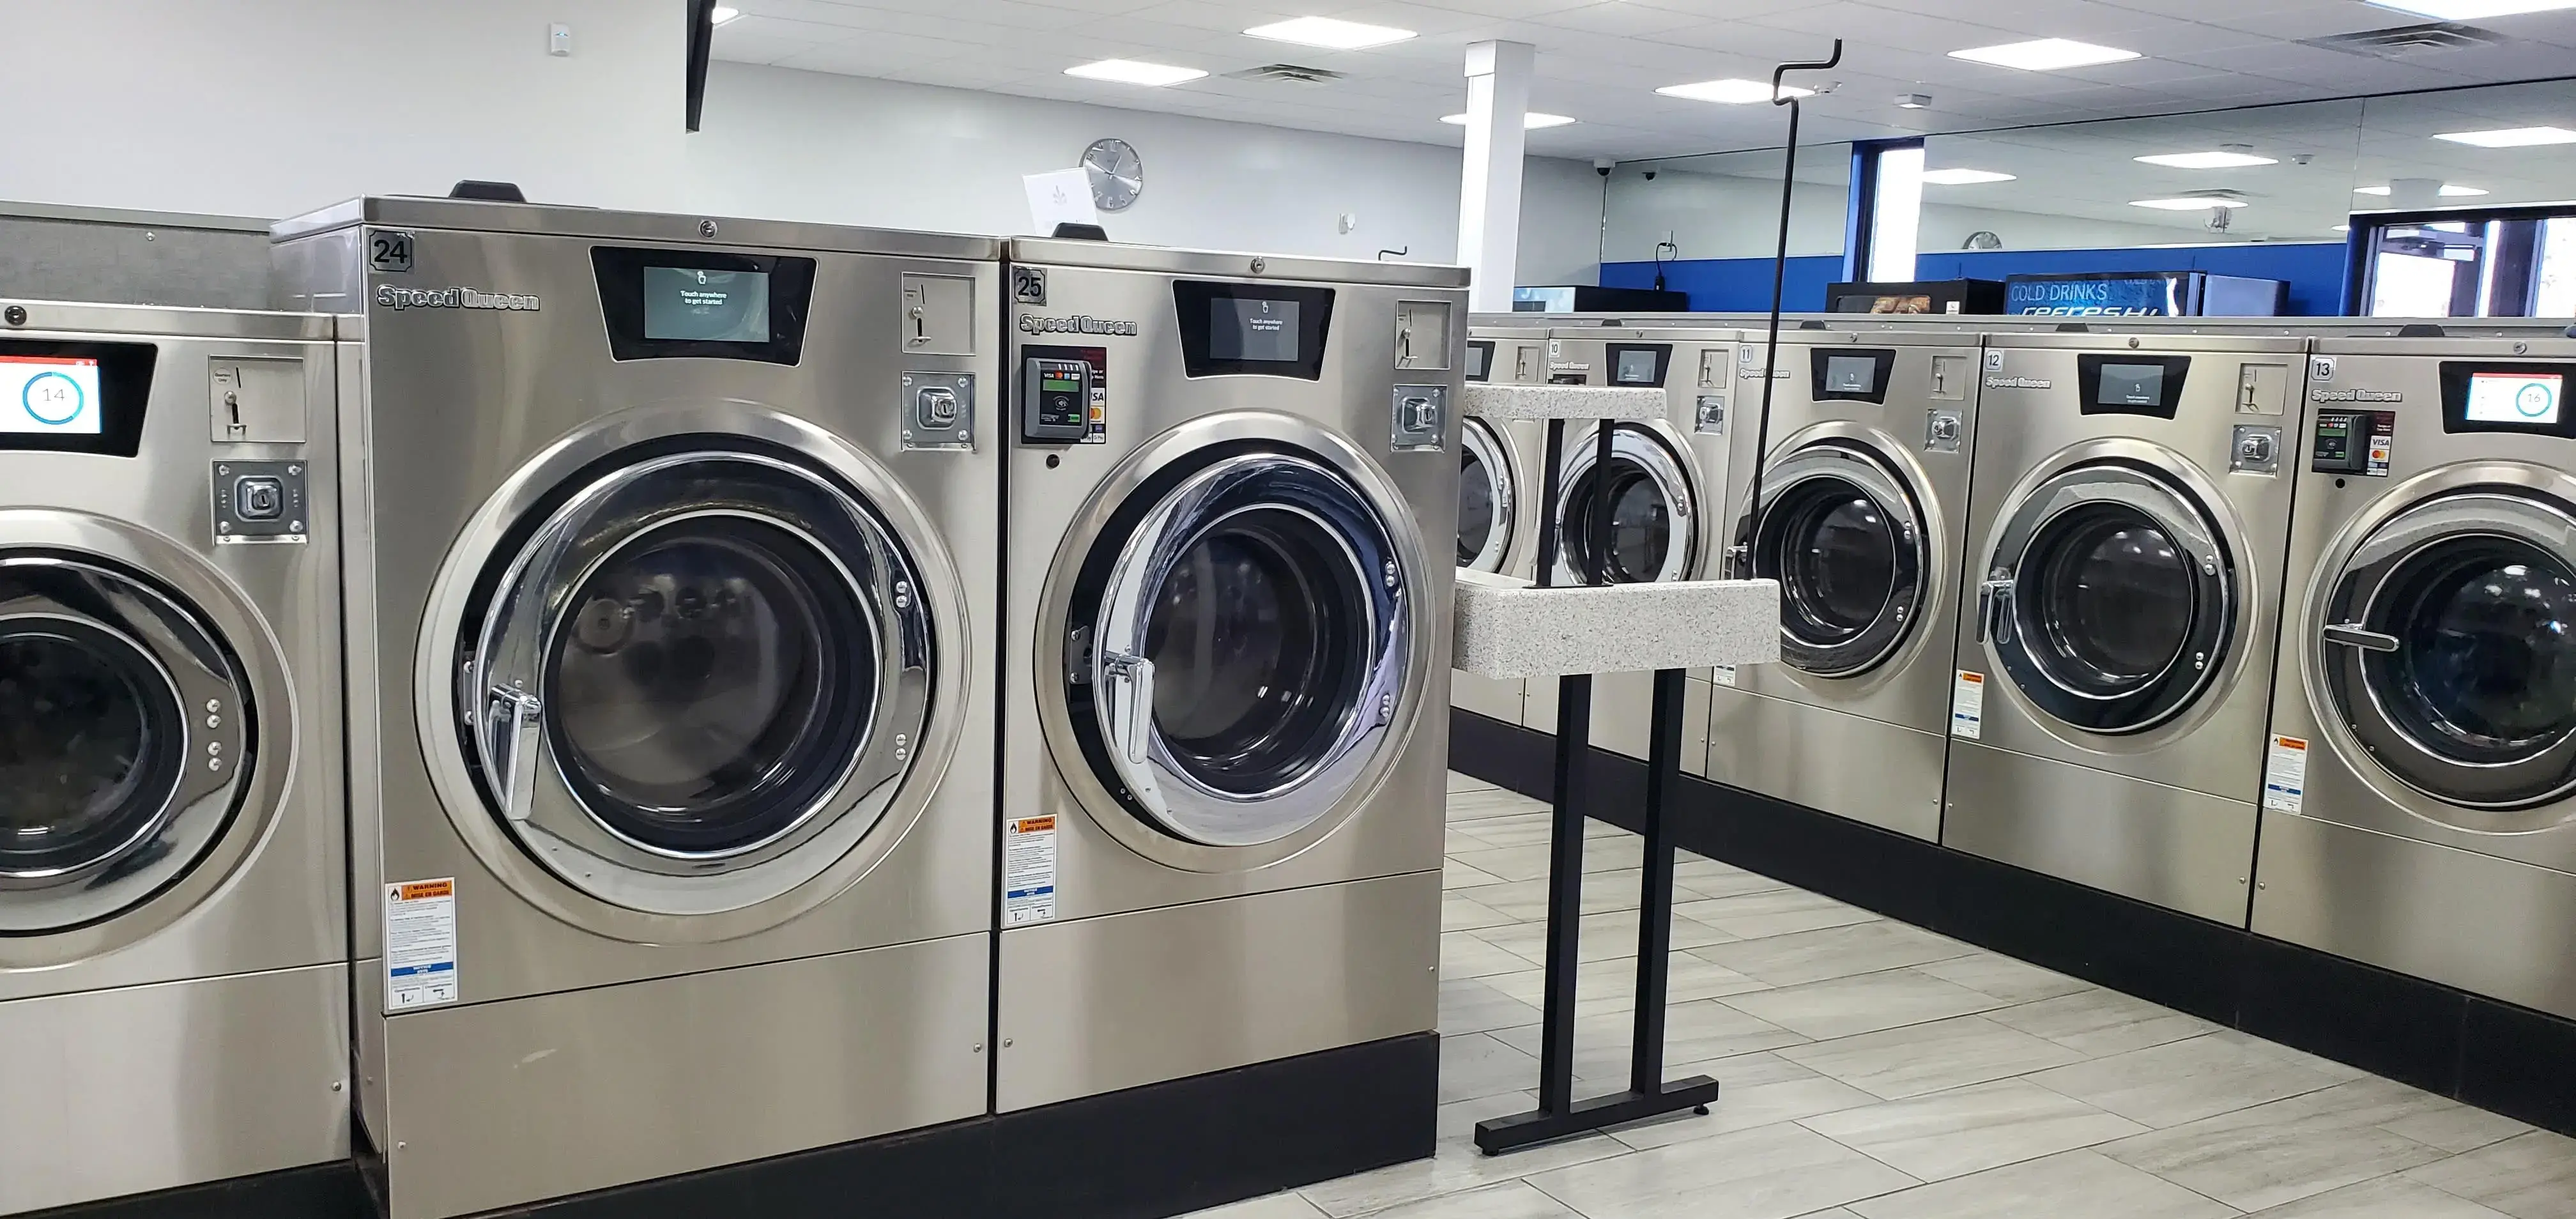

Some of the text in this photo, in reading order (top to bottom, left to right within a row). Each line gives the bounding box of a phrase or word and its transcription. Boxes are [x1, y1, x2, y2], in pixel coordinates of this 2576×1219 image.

[374, 239, 408, 263] 24
[1018, 276, 1042, 297] 25
[2012, 283, 2108, 302] COLD DRINKS
[377, 285, 540, 312] Speed Queen
[1020, 314, 1137, 336] Speed Queen
[1551, 344, 1558, 353] 10
[1742, 349, 1750, 359] 11
[1989, 354, 1999, 366] 12
[1739, 368, 1765, 379] Speed
[2316, 362, 2330, 376] 13
[1985, 376, 2051, 390] Speed Queen
[42, 388, 65, 401] 14
[1091, 392, 1104, 401] ISA
[2311, 388, 2402, 403] Speed Queen
[2527, 393, 2541, 402] 16
[413, 882, 447, 891] WARNING
